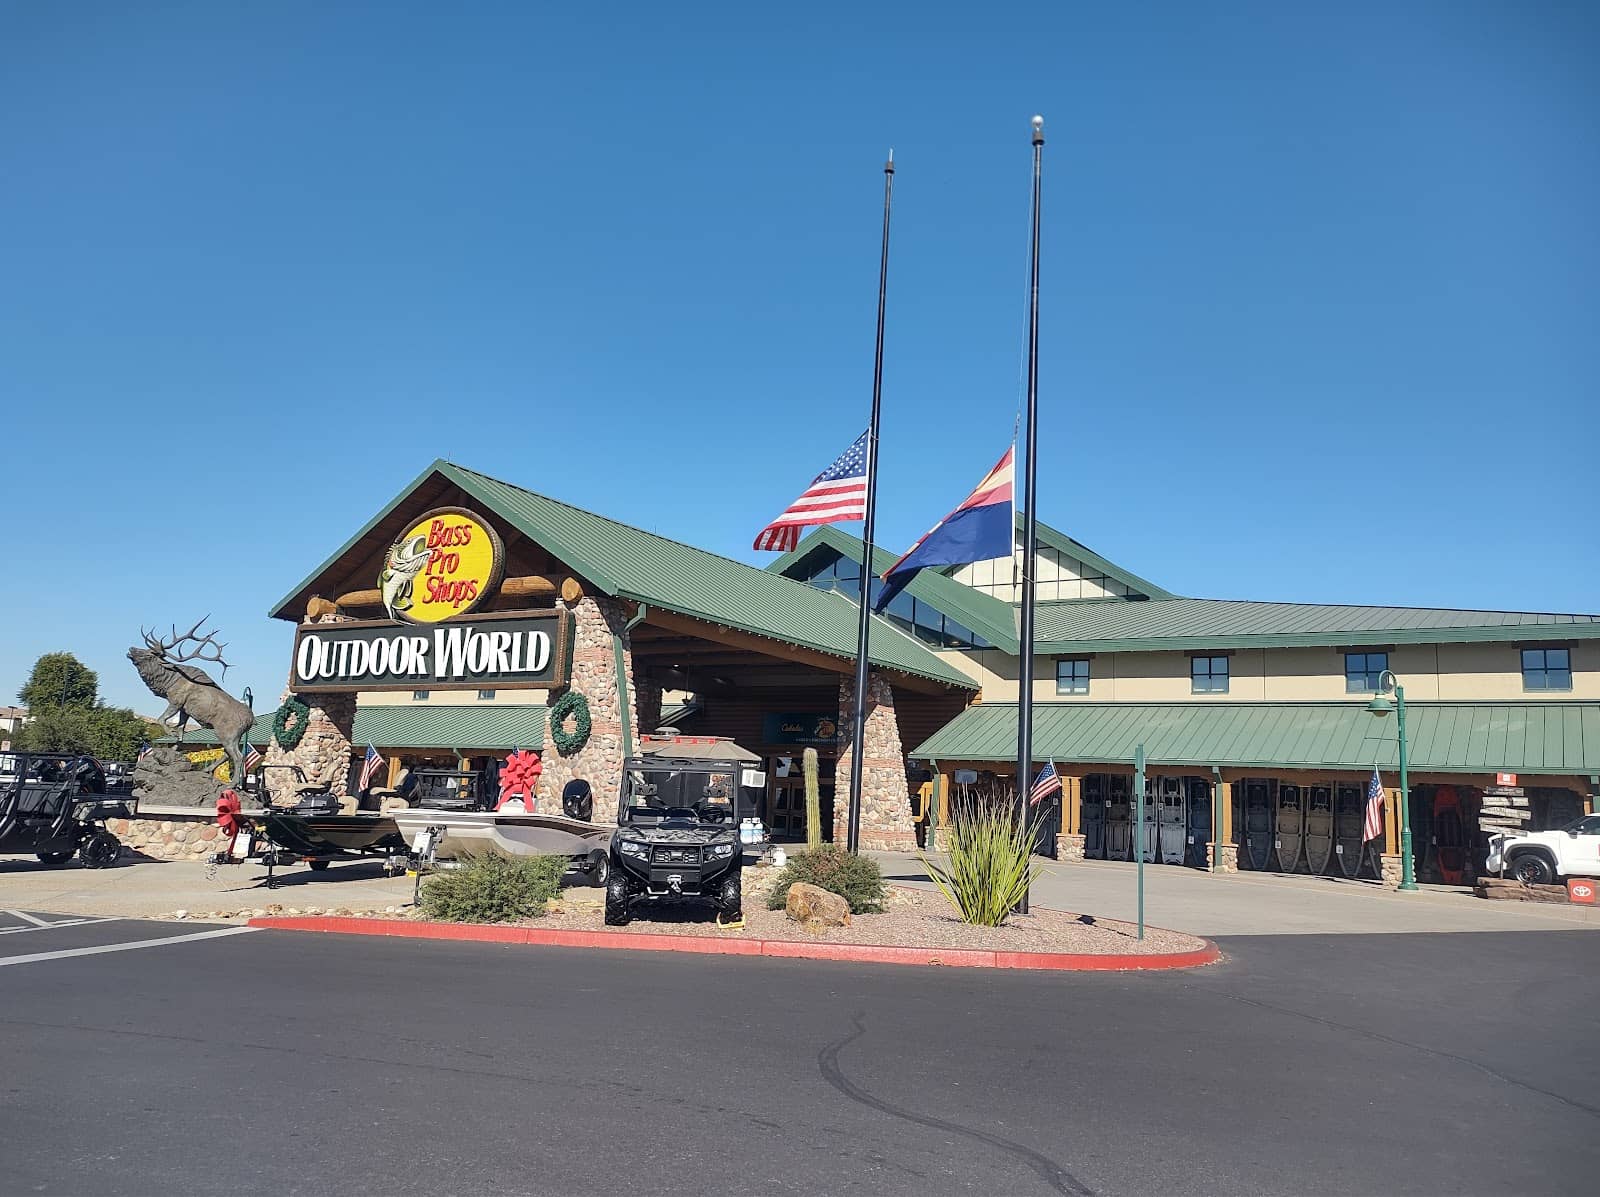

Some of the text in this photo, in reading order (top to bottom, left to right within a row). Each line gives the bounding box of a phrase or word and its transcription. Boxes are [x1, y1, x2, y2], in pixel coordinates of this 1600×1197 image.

[426, 519, 472, 548] Bass
[425, 548, 460, 576] Pro
[422, 575, 479, 609] Shops
[297, 626, 551, 681] OUTDOOR WORLD
